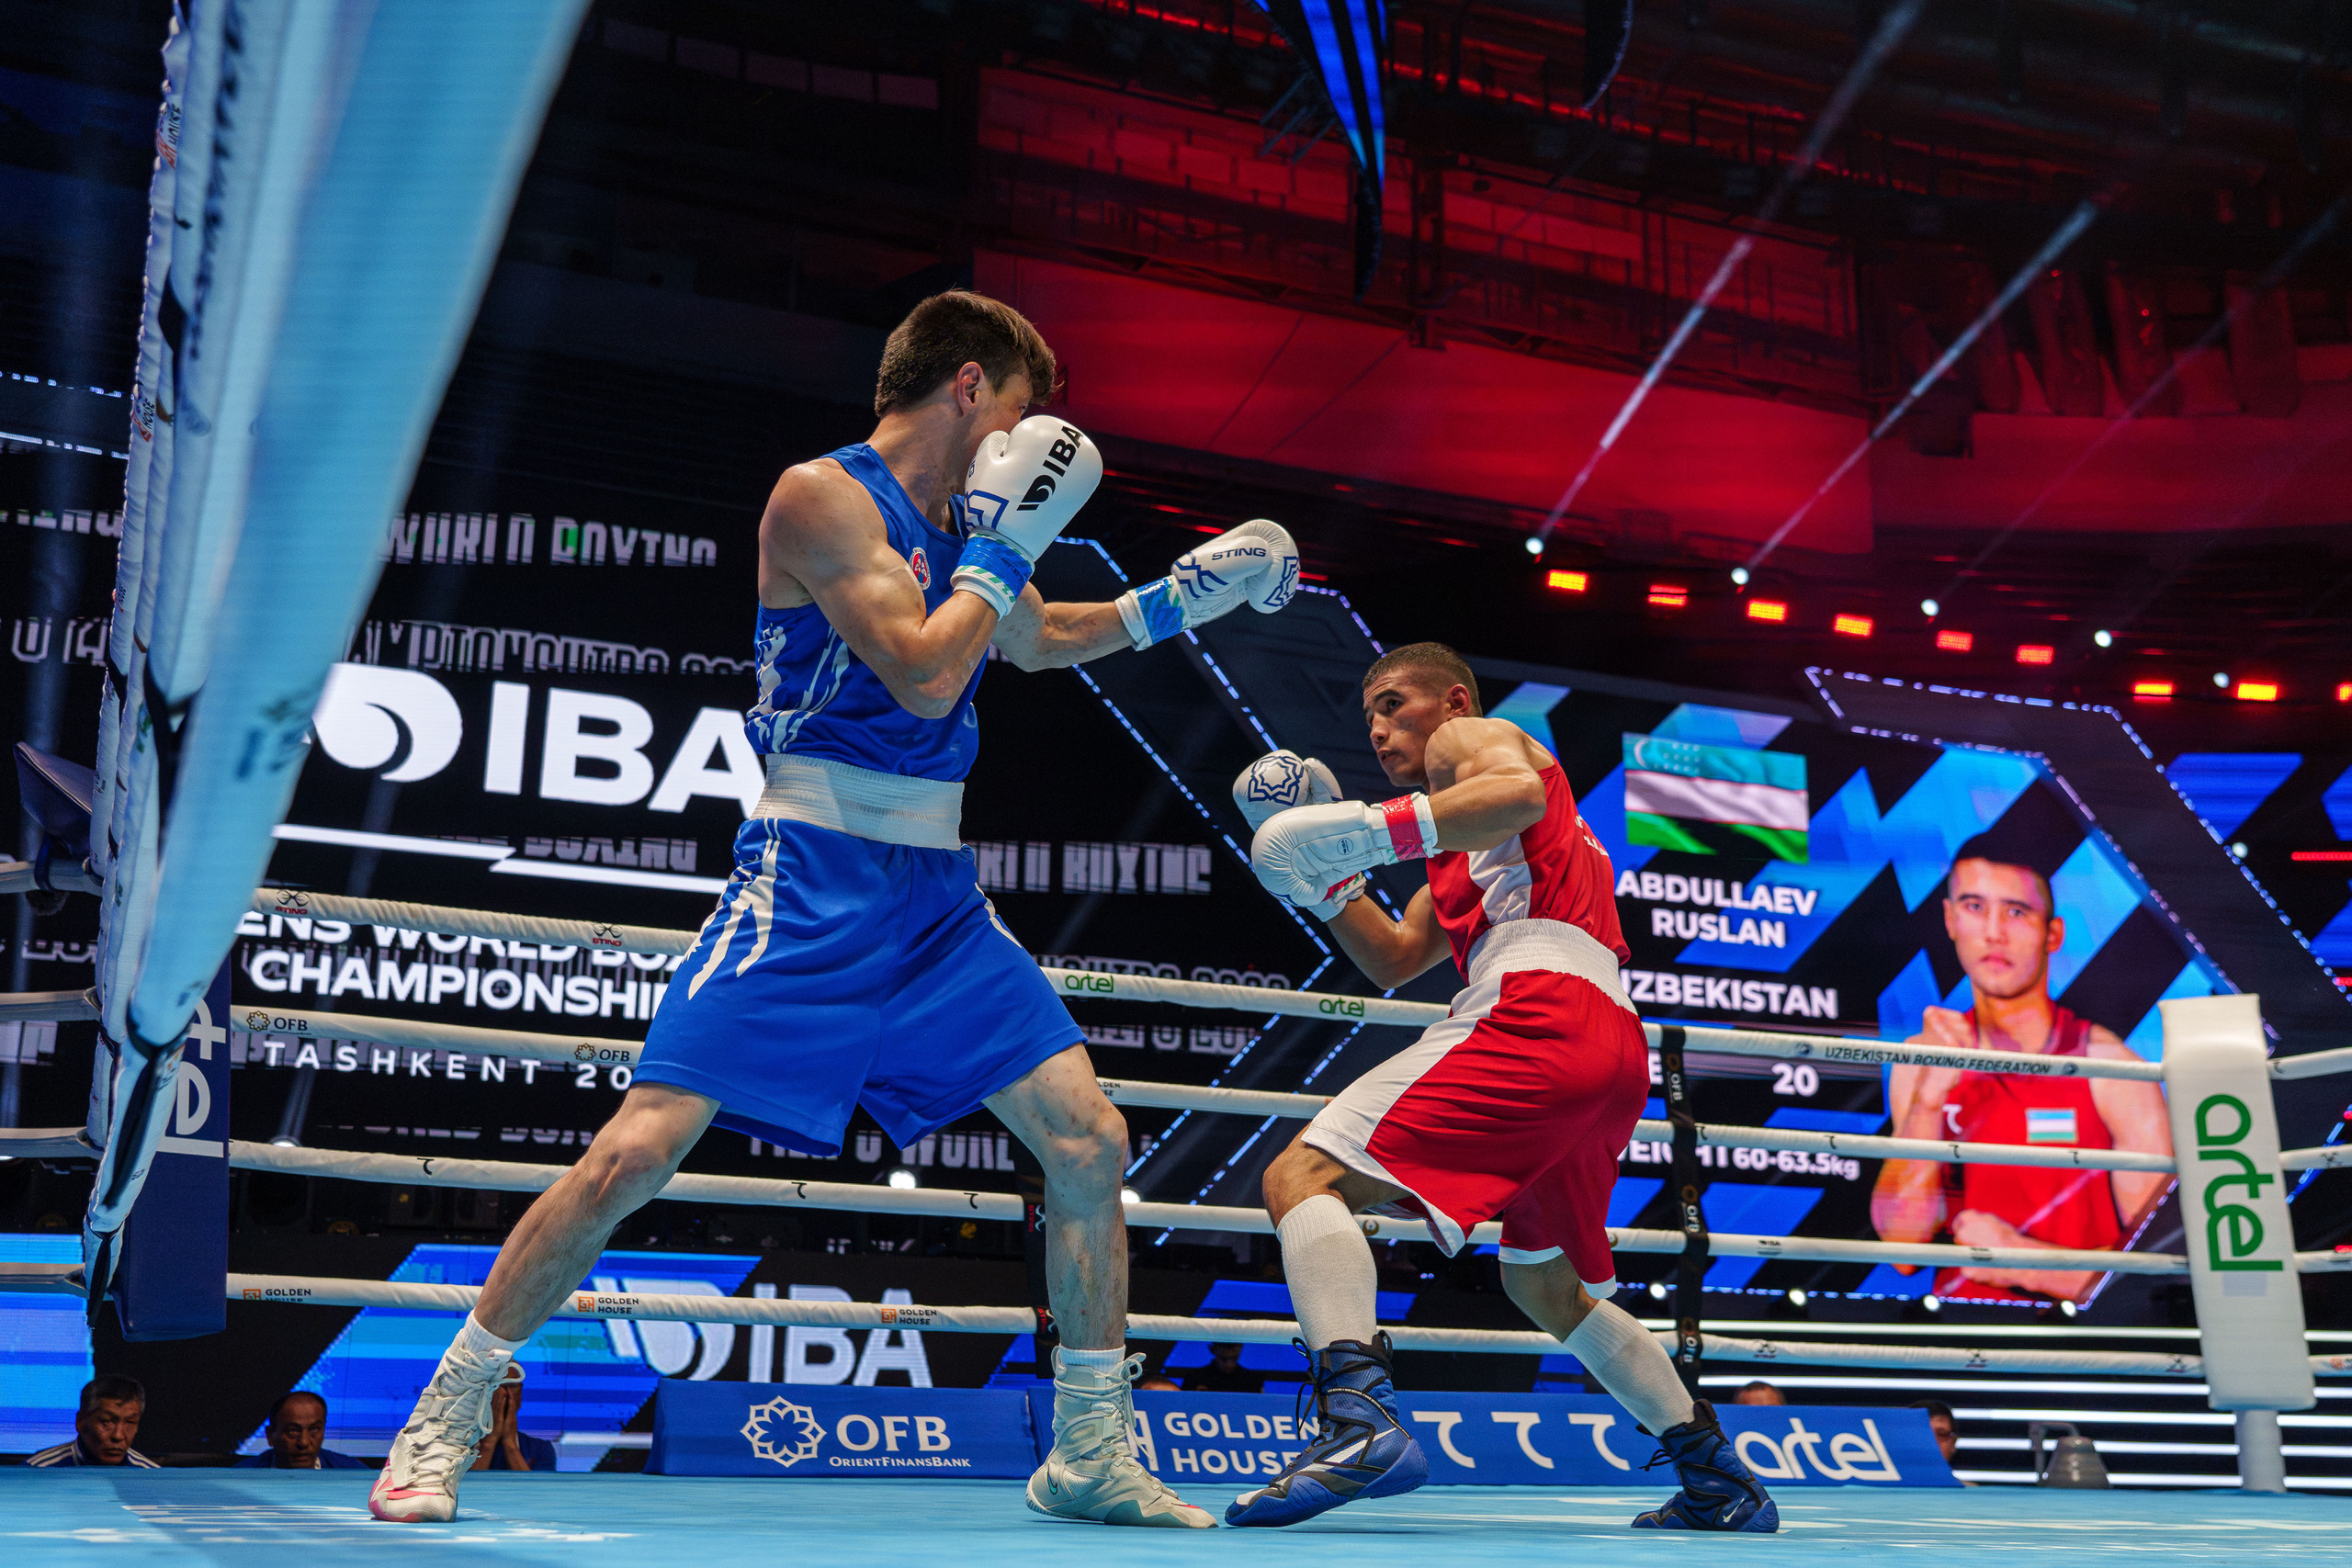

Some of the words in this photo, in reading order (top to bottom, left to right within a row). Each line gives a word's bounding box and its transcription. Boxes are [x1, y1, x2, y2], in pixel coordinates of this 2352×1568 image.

[1043, 425, 1084, 478] IBA
[1211, 547, 1267, 561] STING
[483, 681, 765, 820] IBA
[1615, 870, 1817, 916] ABDULLAEV
[276, 906, 309, 915] STING
[593, 937, 622, 947] STING
[1651, 908, 1787, 949] RUSLAN
[1065, 973, 1114, 993] artel
[1319, 997, 1364, 1017] artel
[274, 1017, 309, 1031] OFB
[263, 1041, 542, 1085] TASHKENT
[599, 1049, 630, 1062] OFB
[1825, 1046, 1910, 1064] UZBEKISTAN
[1914, 1055, 1964, 1068] BOXING
[1968, 1058, 2052, 1074] FEDERATION
[1770, 1063, 1820, 1097] 20
[2195, 1093, 2284, 1272] artel
[597, 1306, 633, 1314] HOUSE
[899, 1317, 931, 1325] HOUSE
[749, 1282, 933, 1389] IBA
[836, 1414, 952, 1452] OFB
[1163, 1411, 1320, 1441] GOLDEN
[1735, 1417, 1902, 1483] artel
